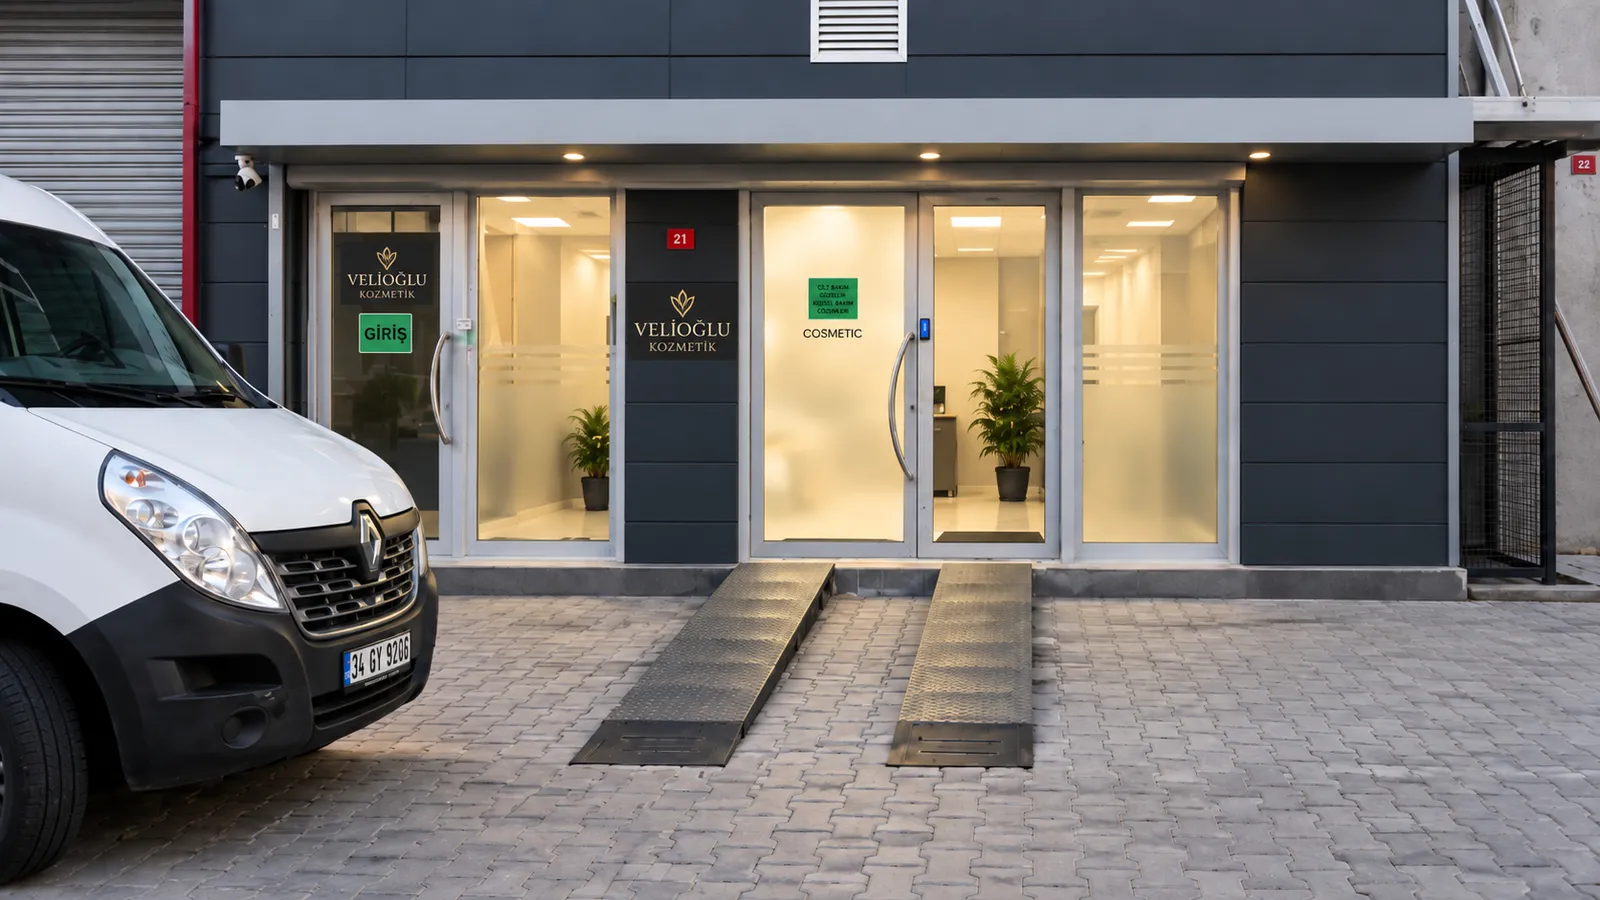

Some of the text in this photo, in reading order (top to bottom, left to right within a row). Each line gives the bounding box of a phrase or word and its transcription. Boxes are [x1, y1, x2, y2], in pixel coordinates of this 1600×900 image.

[1578, 160, 1590, 169] 22
[673, 233, 686, 245] 21
[347, 271, 427, 286] VELİOĞLU
[359, 289, 415, 299] KOZMETİK
[364, 324, 408, 344] GİRİŞ
[634, 319, 731, 337] VELİOĞLU
[803, 328, 863, 339] COSMETIC
[649, 341, 717, 352] KOZMETİK
[351, 652, 364, 679] 34
[369, 646, 382, 673] GY
[386, 636, 408, 666] 9206
